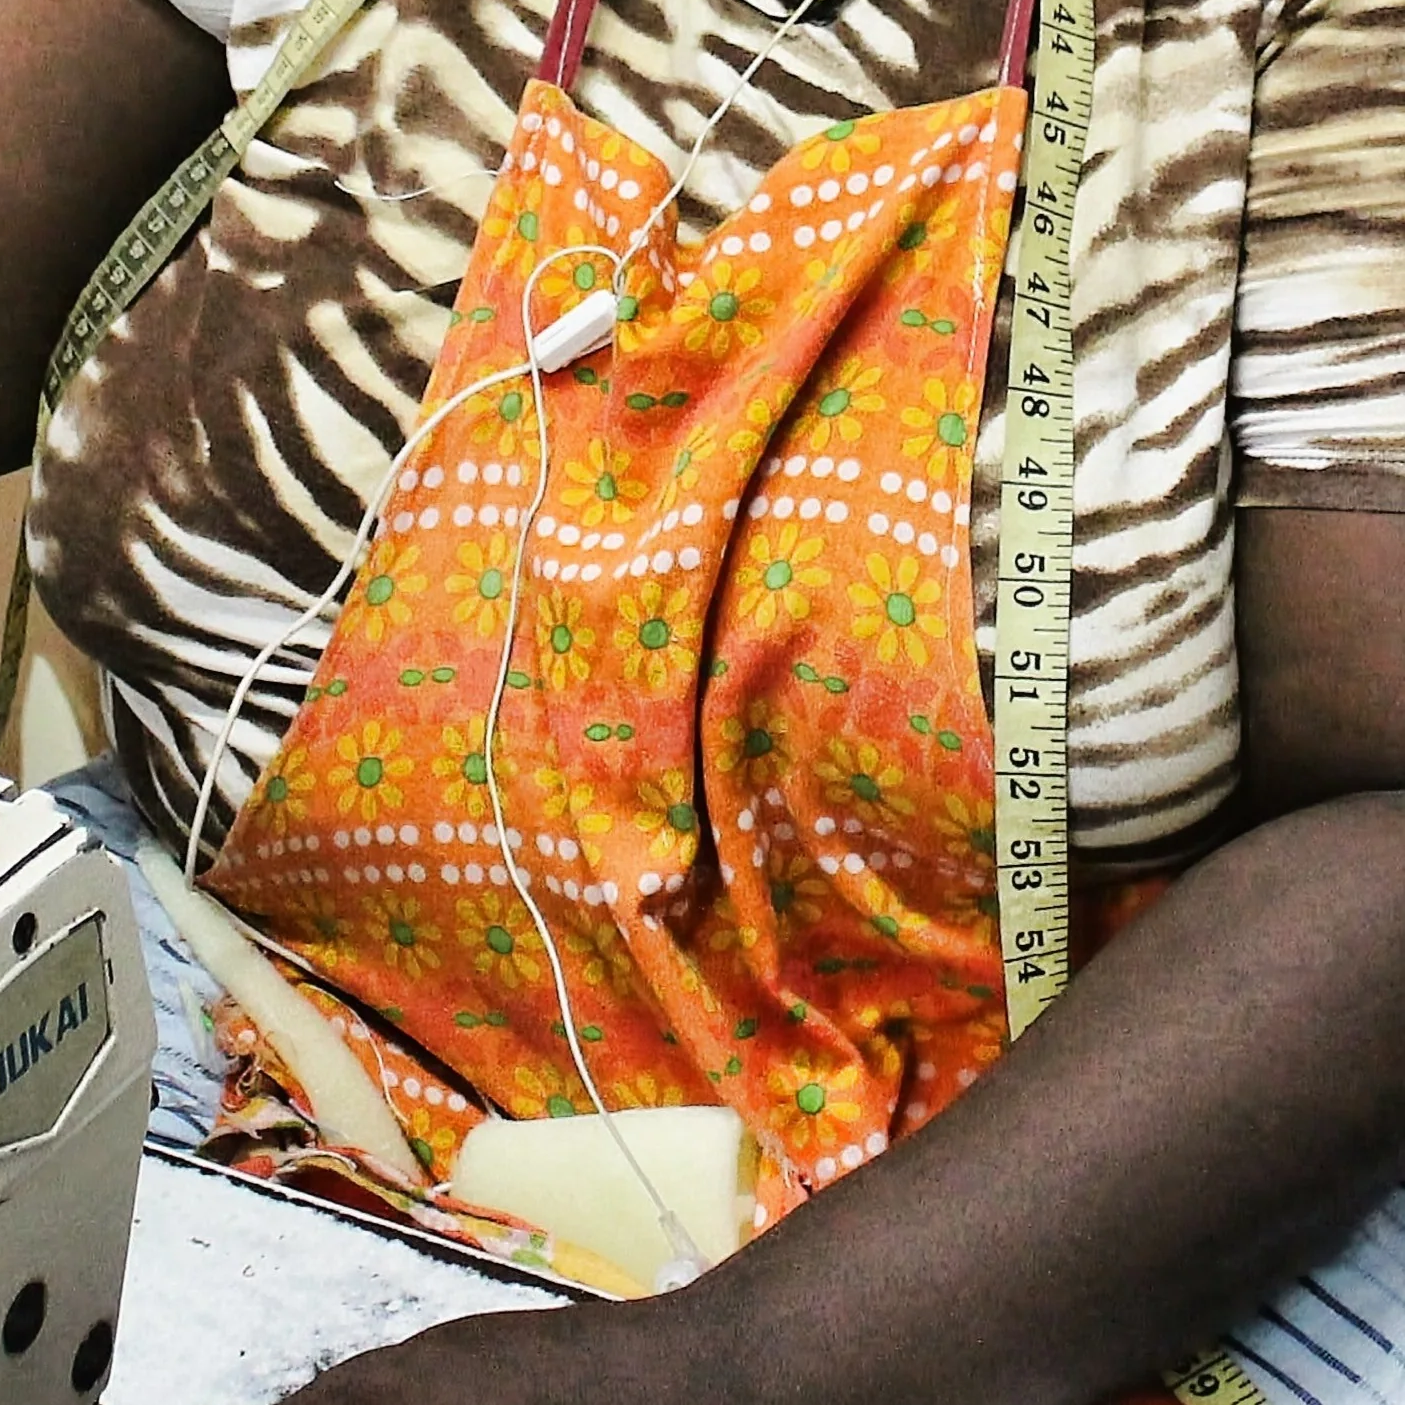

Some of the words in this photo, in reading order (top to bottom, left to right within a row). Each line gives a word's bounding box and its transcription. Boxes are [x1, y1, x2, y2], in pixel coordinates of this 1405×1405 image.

[1051, 3, 1076, 54] 44
[1043, 92, 1069, 146] 45
[1033, 181, 1058, 236] 46
[1026, 272, 1051, 329] 47
[1021, 363, 1050, 419] 48
[1018, 456, 1048, 511] 49
[1013, 552, 1045, 608] 50
[1009, 650, 1041, 702] 51
[1009, 747, 1041, 800] 52
[1010, 840, 1042, 891] 53
[1015, 930, 1046, 984] 54
